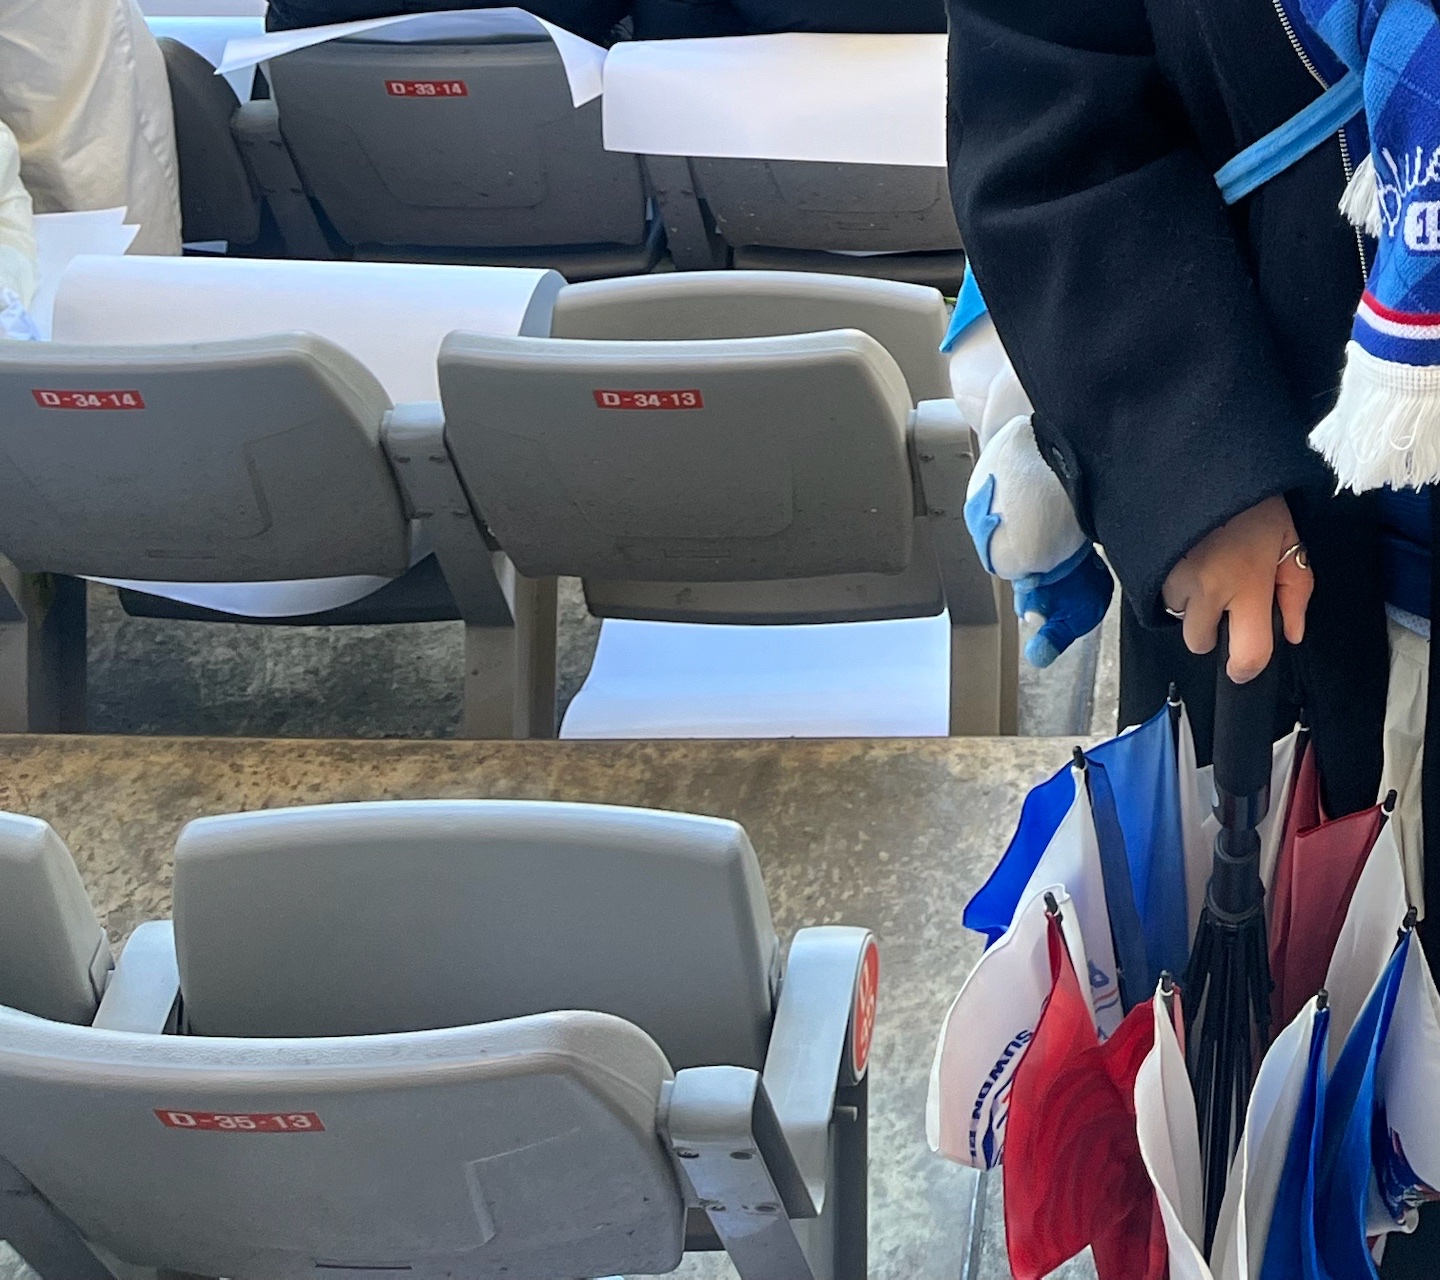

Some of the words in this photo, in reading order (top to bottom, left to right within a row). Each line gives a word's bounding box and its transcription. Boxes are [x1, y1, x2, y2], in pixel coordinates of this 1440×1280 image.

[40, 391, 138, 407] D-34-14
[601, 392, 696, 407] D-34-13
[971, 1029, 1035, 1121] SUWON
[167, 1111, 312, 1130] D-35-13
